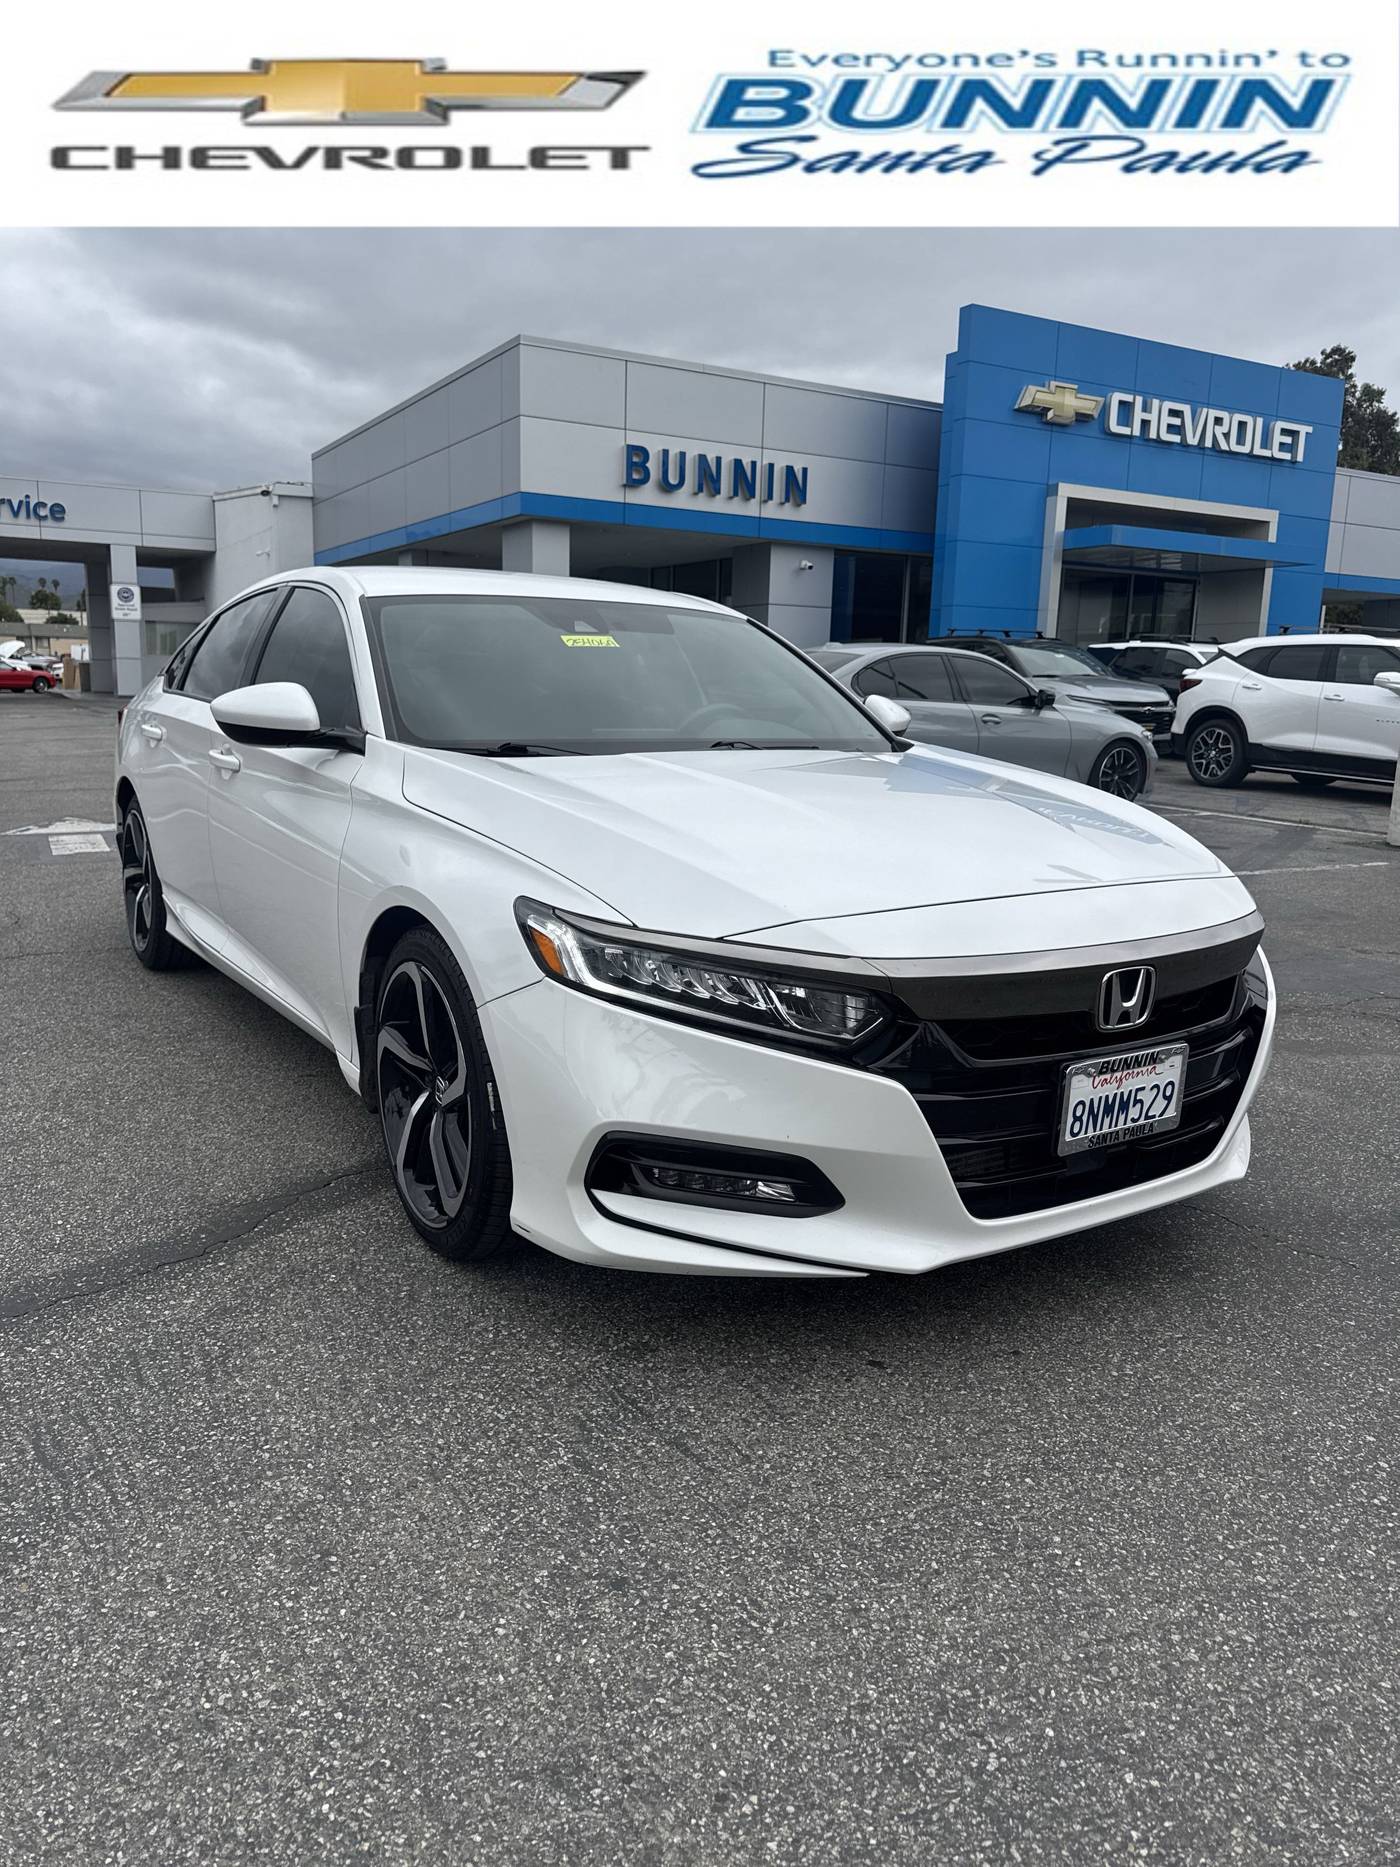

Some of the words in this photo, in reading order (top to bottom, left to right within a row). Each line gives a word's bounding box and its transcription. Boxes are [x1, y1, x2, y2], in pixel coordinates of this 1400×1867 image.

[1107, 391, 1314, 463] CHEVROLET
[624, 443, 809, 506] BUNNIN
[1091, 1064, 1164, 1090] California
[1098, 1051, 1160, 1075] BUNNIN
[1069, 1080, 1176, 1138] 8NMM529
[1088, 1130, 1120, 1149] SANTA
[1122, 1122, 1154, 1141] PAULA
